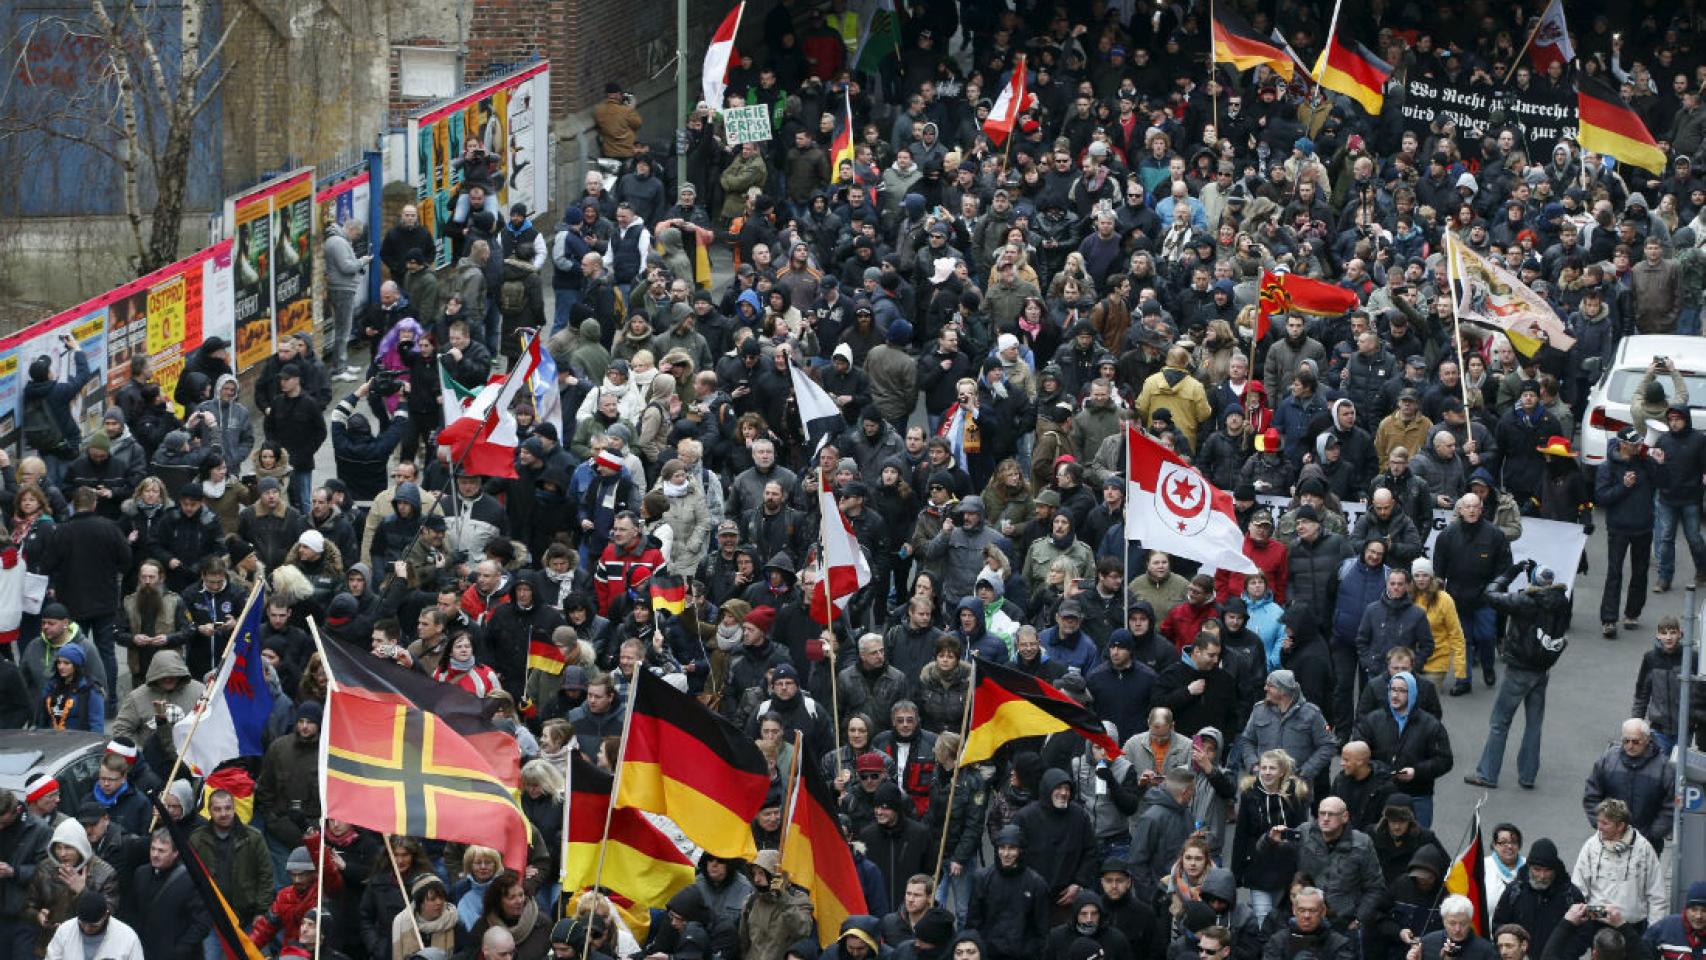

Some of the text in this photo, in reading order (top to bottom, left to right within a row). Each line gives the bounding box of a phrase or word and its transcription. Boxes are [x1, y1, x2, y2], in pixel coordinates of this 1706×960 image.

[1410, 81, 1437, 98] Wo
[1442, 87, 1486, 110] Recht
[728, 106, 766, 119] ANGIE
[1401, 104, 1434, 121] wird
[1530, 126, 1557, 141] zur
[150, 283, 183, 313] OSTPRO
[1685, 787, 1701, 809] P
